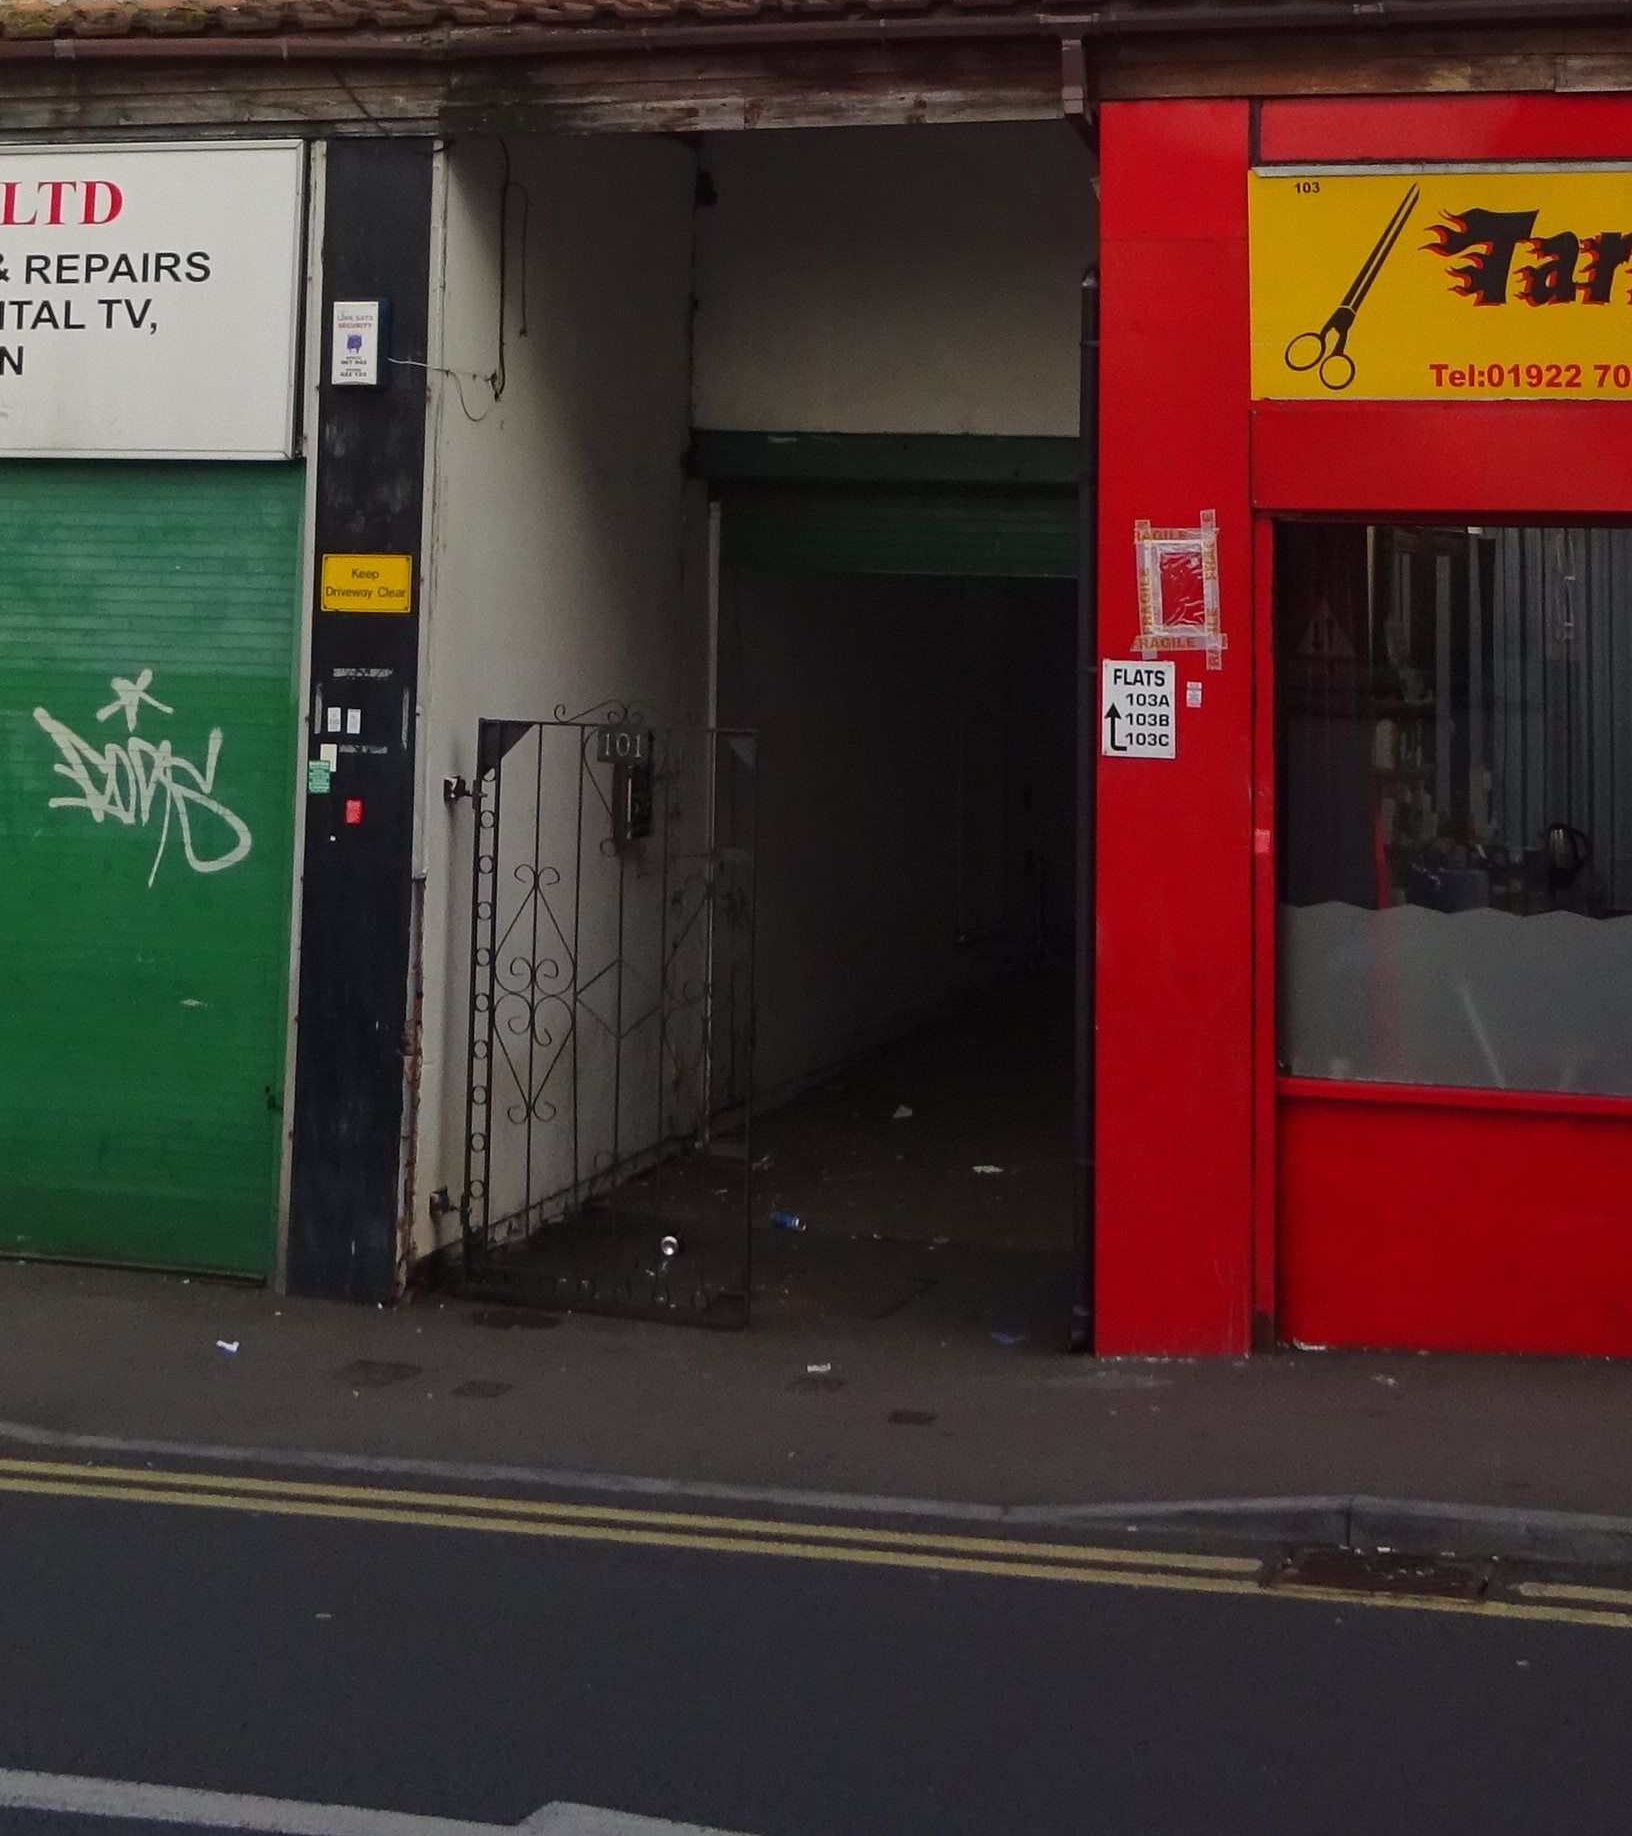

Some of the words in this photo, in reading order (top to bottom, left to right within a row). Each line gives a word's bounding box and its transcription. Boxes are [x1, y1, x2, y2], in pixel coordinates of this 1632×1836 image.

[1294, 181, 1321, 194] 103
[25, 251, 211, 285] REPAIRS
[97, 298, 158, 335] TV,
[1429, 363, 1582, 389] Tel:01922
[351, 568, 380, 580] Keep
[325, 586, 373, 600] Driveway
[377, 586, 406, 598] Clear
[1113, 669, 1166, 687] FLATS
[1125, 693, 1170, 707] 103A
[1125, 713, 1170, 727] 103B
[605, 732, 642, 758] 101
[1125, 733, 1170, 747] 103C
